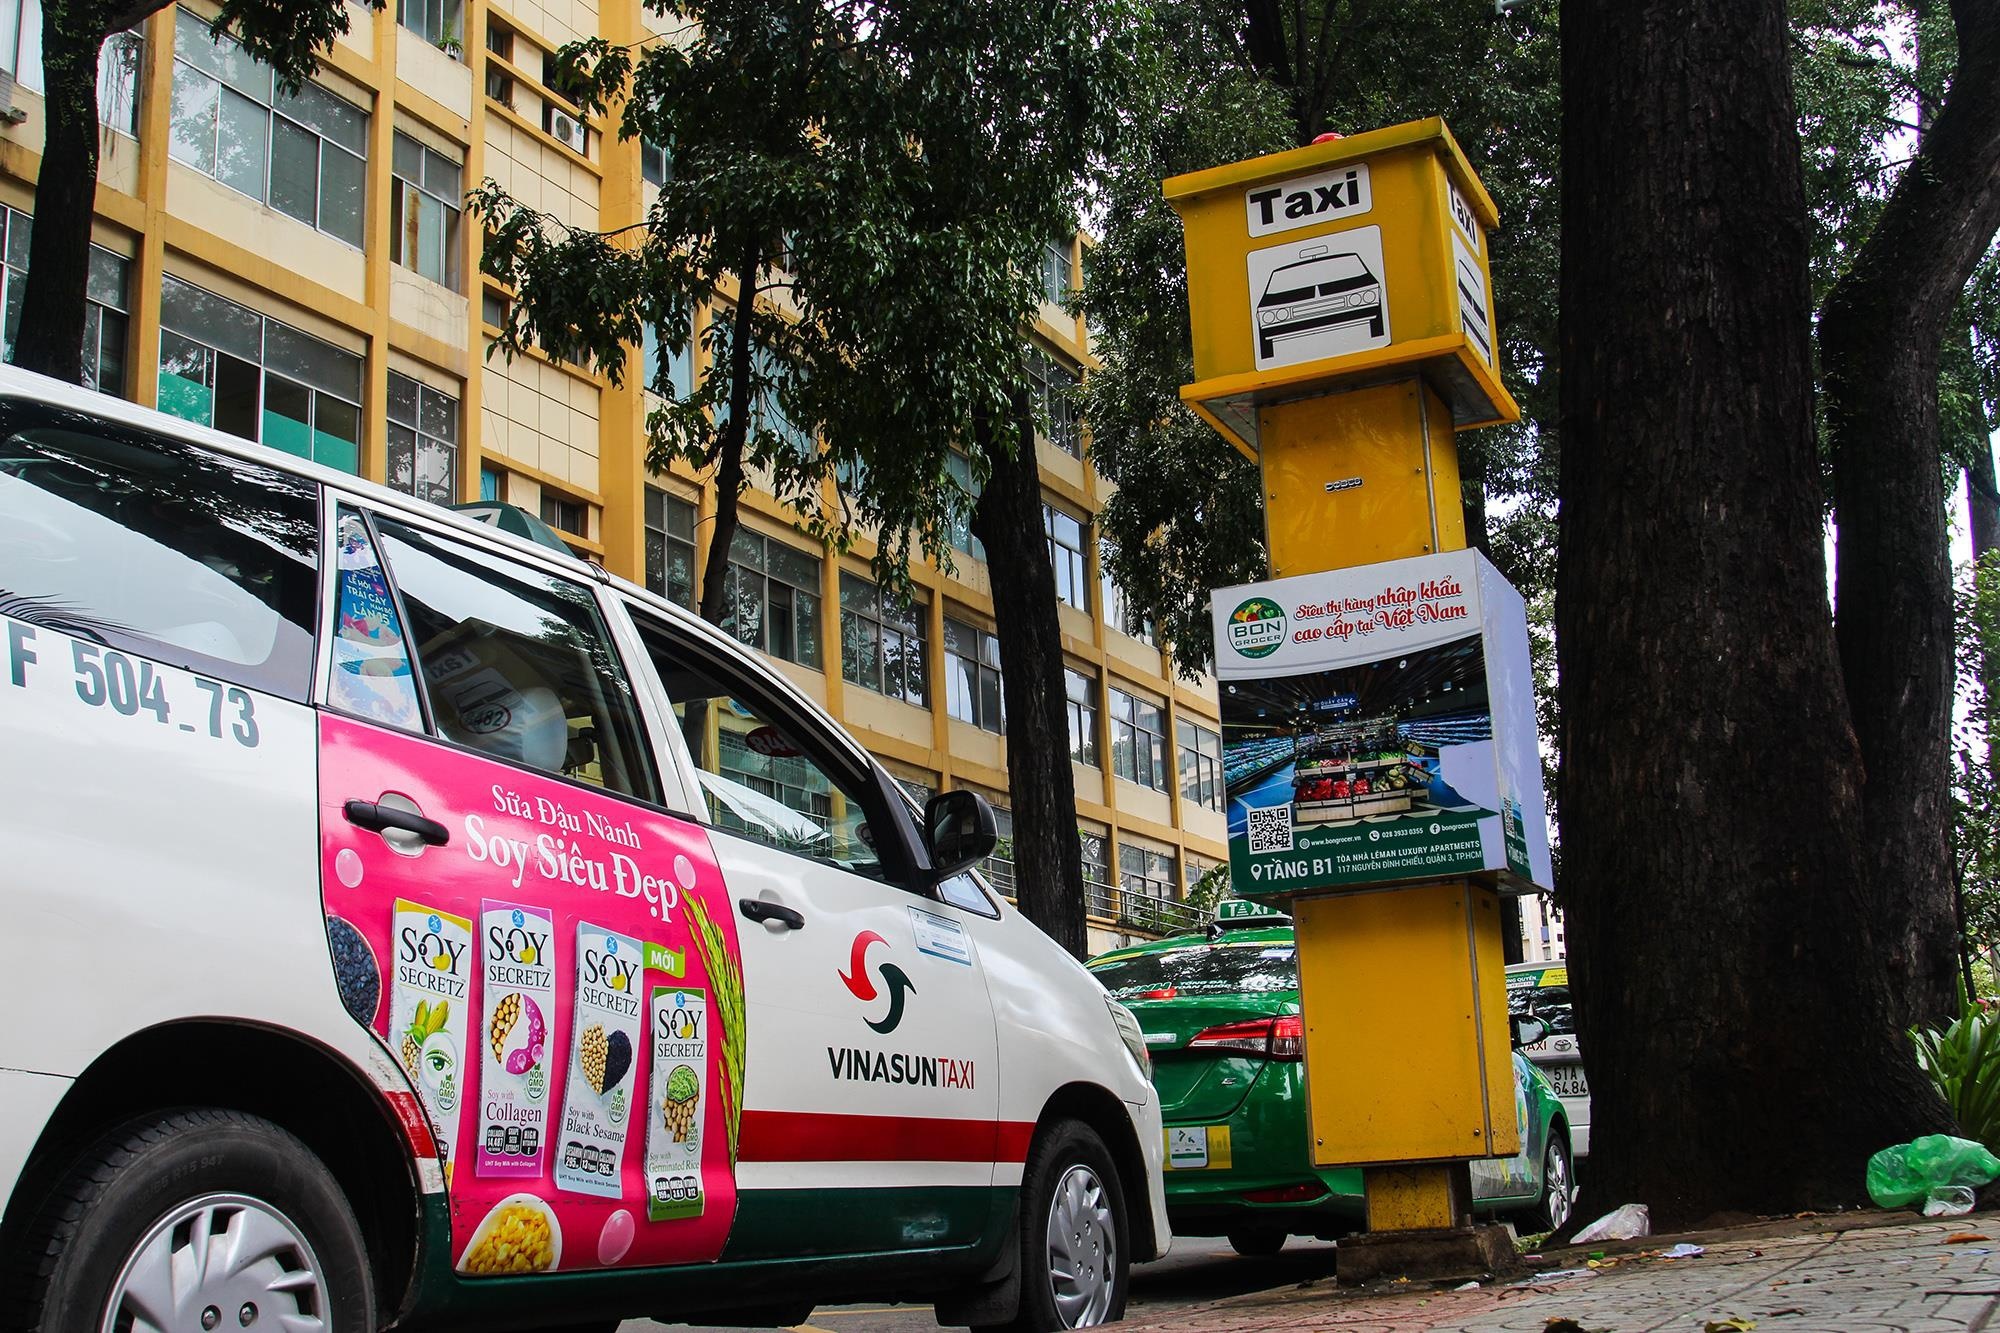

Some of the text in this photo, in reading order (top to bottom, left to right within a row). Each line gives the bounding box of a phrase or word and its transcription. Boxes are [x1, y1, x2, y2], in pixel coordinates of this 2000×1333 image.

[1250, 170, 1360, 225] Taxi
[1448, 176, 1477, 245] Taxi
[1294, 575, 1462, 620] Siêu thị hàng nhập khẩu
[1234, 620, 1280, 638] BON
[1293, 602, 1468, 644] cao cấp tại Việt Nam
[1235, 635, 1280, 647] GROCER
[8, 620, 37, 688] F
[492, 784, 642, 850] Sữa Đậu Nành
[1442, 822, 1476, 832] bongrocervn
[1311, 835, 1362, 846] www.bongrocer.vn
[1336, 840, 1480, 863] TÒA NHÀ LÉMAN LUXURY APARTMENTS
[464, 814, 679, 925] Soy Siêu Đẹp
[1264, 858, 1332, 880] TẦNG B1
[1338, 866, 1350, 874] 117
[1382, 858, 1400, 868] ĐÌNH
[1426, 854, 1446, 865] QUẬN
[1456, 850, 1482, 860] TP.HCM
[1228, 902, 1268, 917] TAXI
[400, 927, 466, 976] SOY
[489, 926, 548, 966] SOY
[584, 949, 638, 995] SOY
[651, 950, 674, 972] MỚI
[400, 966, 465, 998] SECRETZ
[490, 965, 550, 988] SECRETZ
[583, 987, 638, 1016] SECRETZ
[658, 1008, 703, 1040] SOY
[658, 1043, 704, 1058] SECRETZ
[440, 1080, 456, 1090] NON
[528, 1078, 544, 1088] GMO
[530, 1070, 544, 1079] NON
[439, 1088, 456, 1099] GMO
[488, 1089, 514, 1100] Soy with
[612, 1094, 626, 1104] NON
[486, 1102, 542, 1126] Collagen
[568, 1106, 595, 1120] Soy with
[611, 1102, 625, 1112] GMO
[566, 1118, 625, 1142] Black Sesame
[649, 1160, 700, 1172] Germinated Rice
[650, 1152, 672, 1162] Soy with
